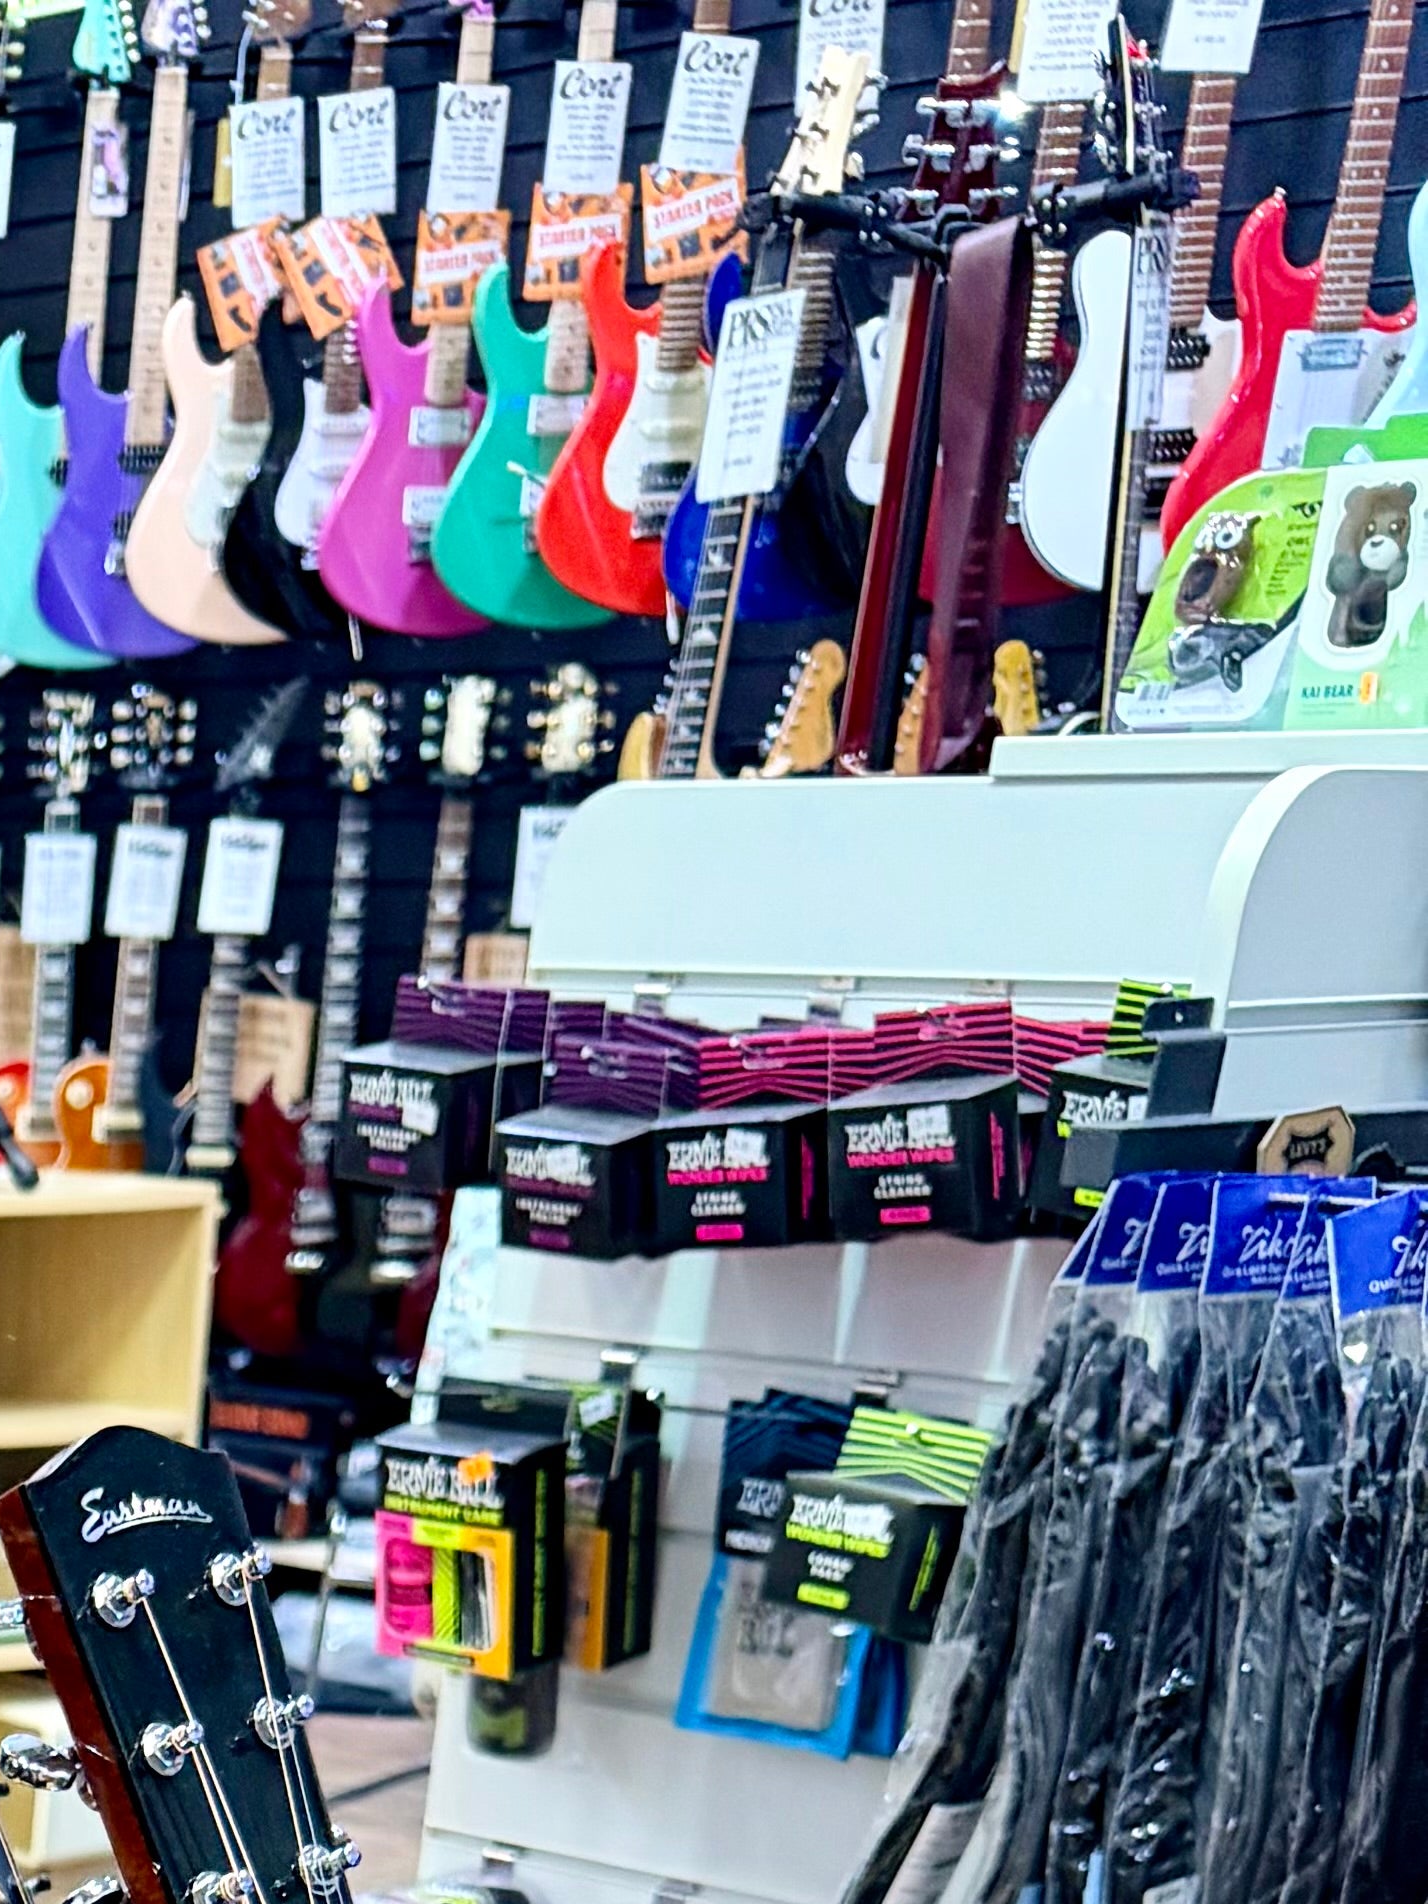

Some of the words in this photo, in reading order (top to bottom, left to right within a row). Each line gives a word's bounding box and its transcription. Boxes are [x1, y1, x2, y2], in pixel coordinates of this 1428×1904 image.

[682, 40, 750, 76] Cort
[559, 68, 624, 101] Cort
[1060, 1089, 1128, 1126] ERNIE
[845, 1112, 907, 1154] ERNIE
[846, 1151, 908, 1169] WONDER
[386, 1455, 446, 1500] ERNIE
[81, 1487, 213, 1543] Eastman
